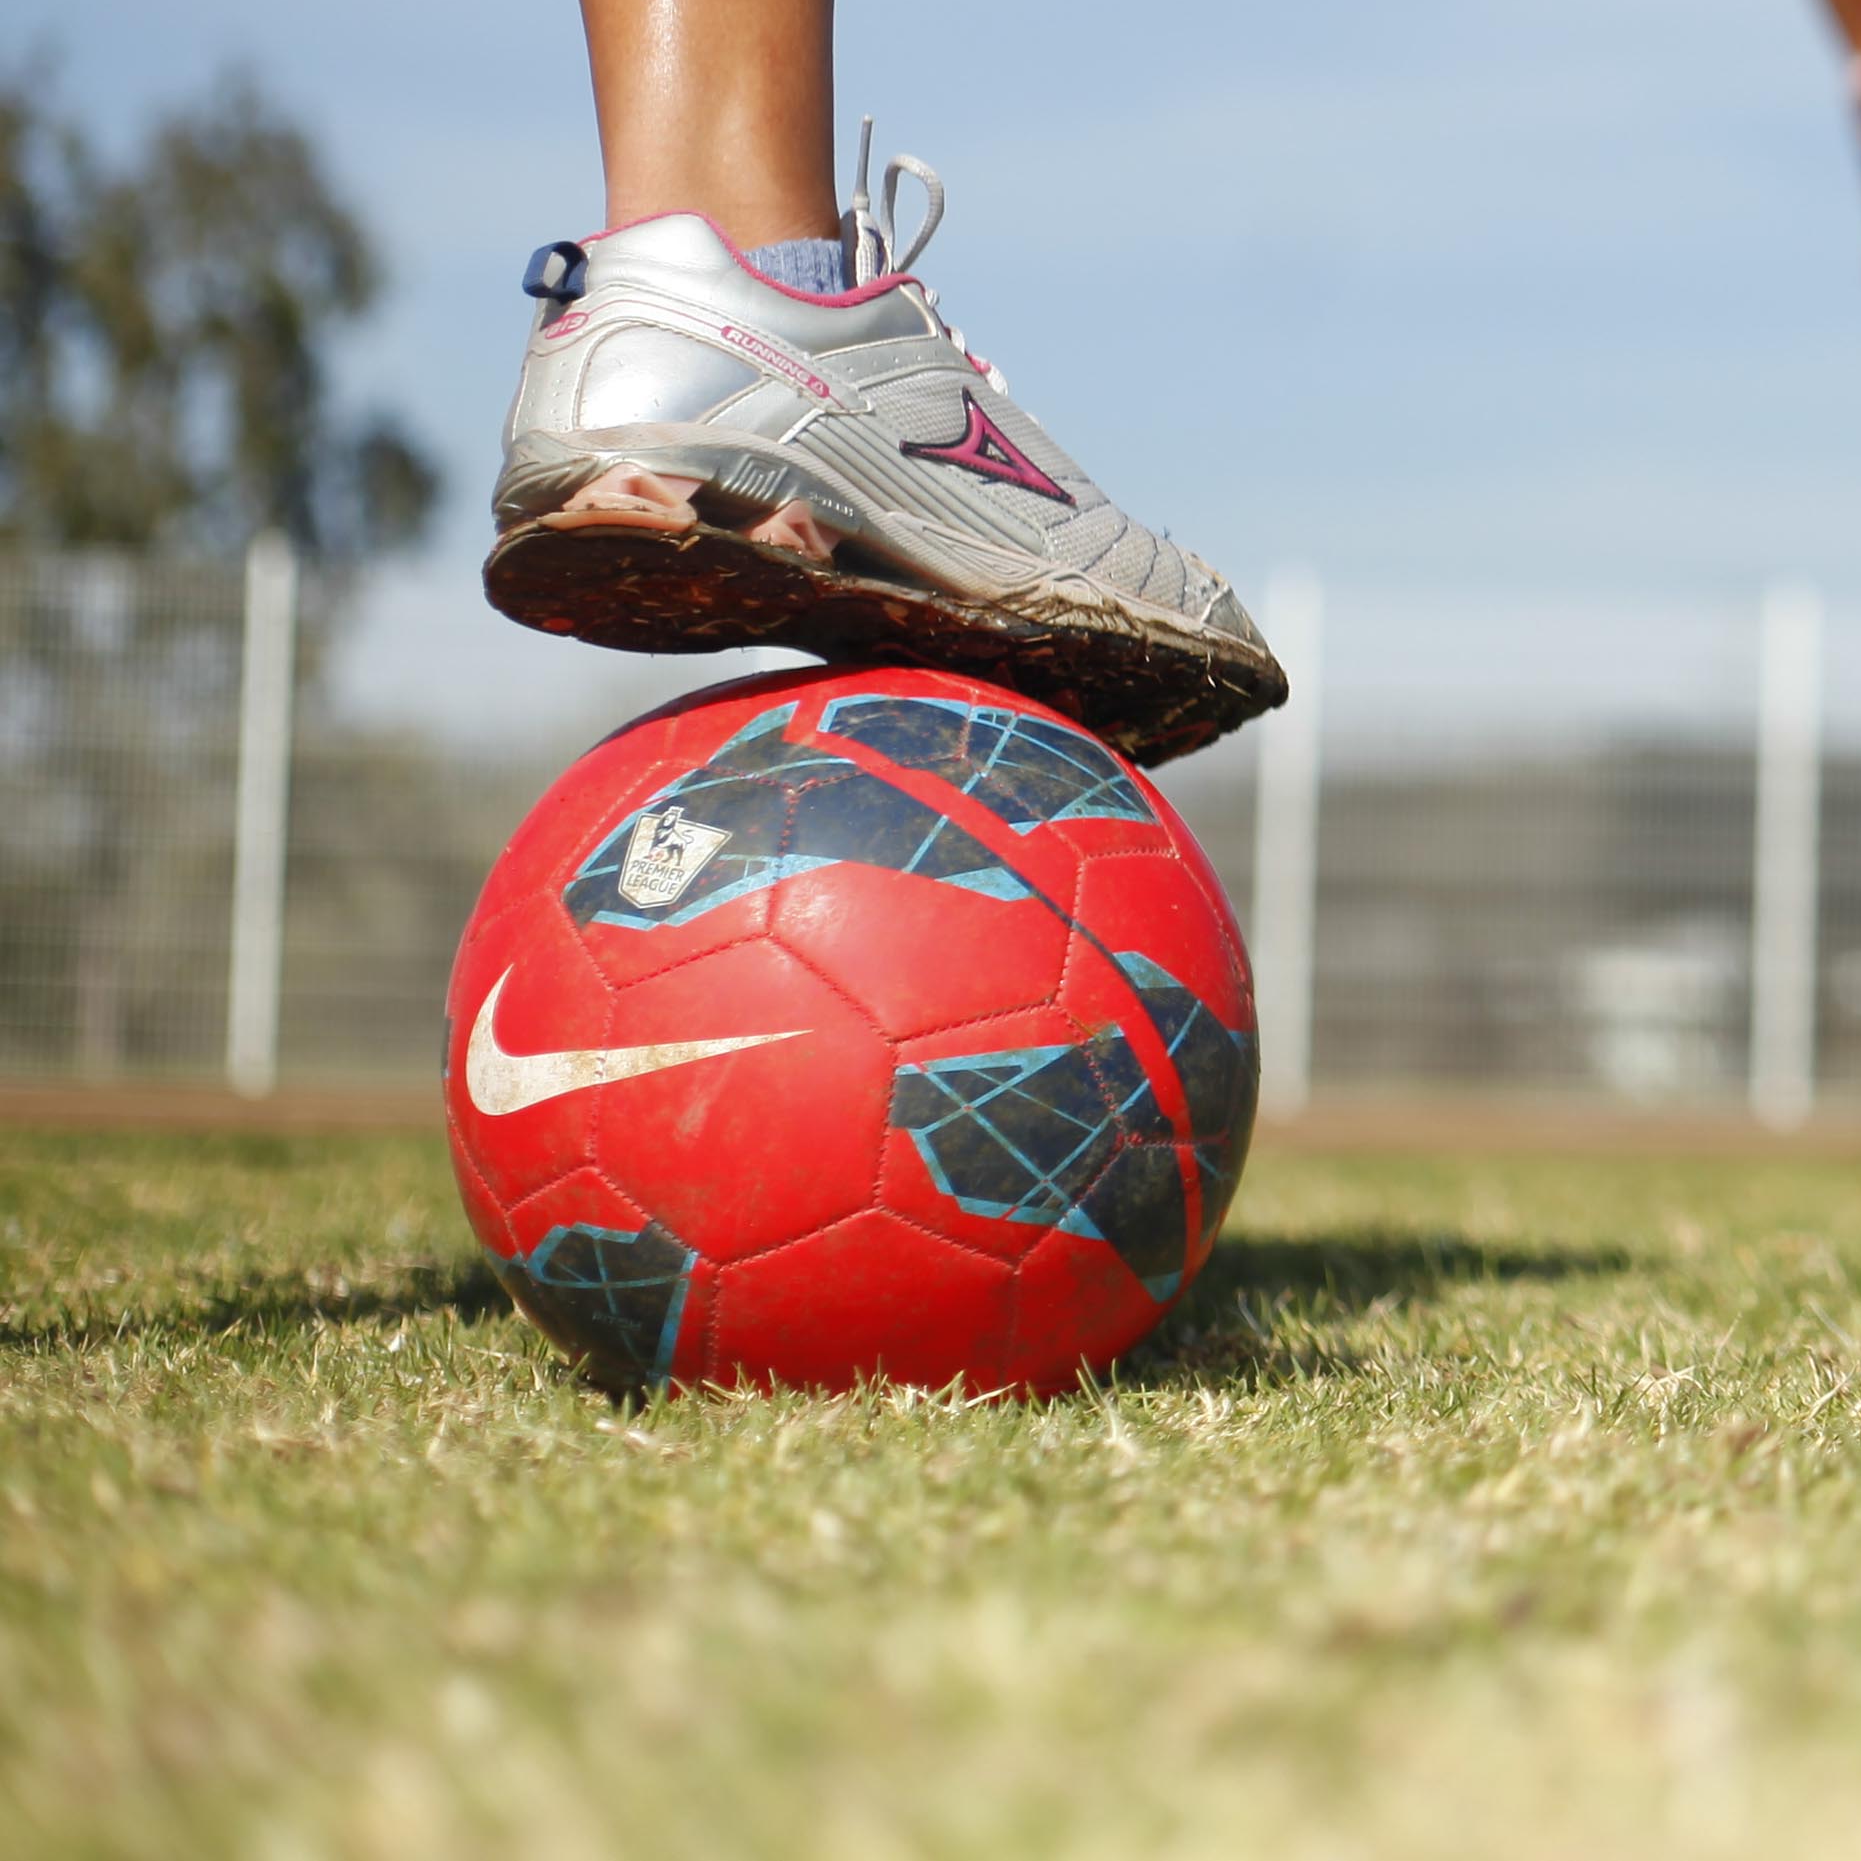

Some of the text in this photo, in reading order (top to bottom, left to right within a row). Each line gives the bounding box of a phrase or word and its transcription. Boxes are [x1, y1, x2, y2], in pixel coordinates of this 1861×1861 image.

[726, 329, 811, 383] RUNNING
[630, 860, 685, 882] PREMIER
[627, 873, 678, 895] LEAGUE
